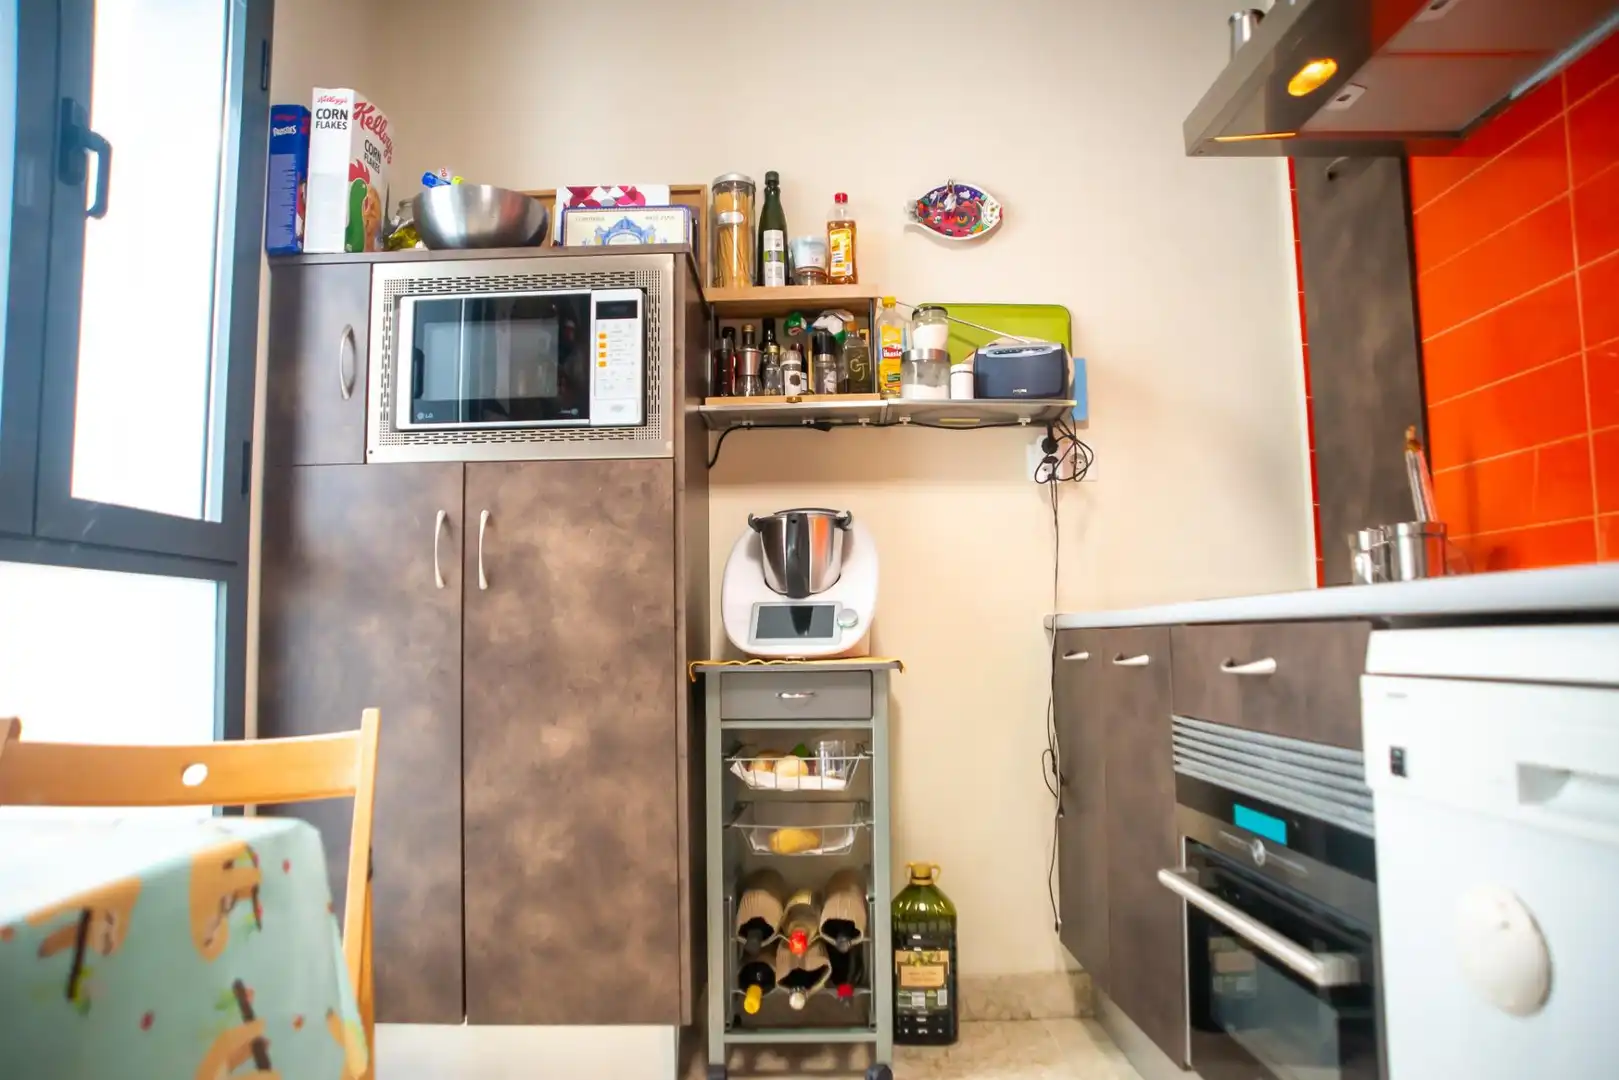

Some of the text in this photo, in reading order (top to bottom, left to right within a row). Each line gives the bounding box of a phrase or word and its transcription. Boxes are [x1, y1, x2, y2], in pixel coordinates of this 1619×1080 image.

[315, 108, 349, 120] CORN
[315, 120, 348, 130] FLAKES
[353, 102, 393, 165] Kellogg's
[364, 139, 382, 164] CORN
[363, 152, 381, 175] FLAKES
